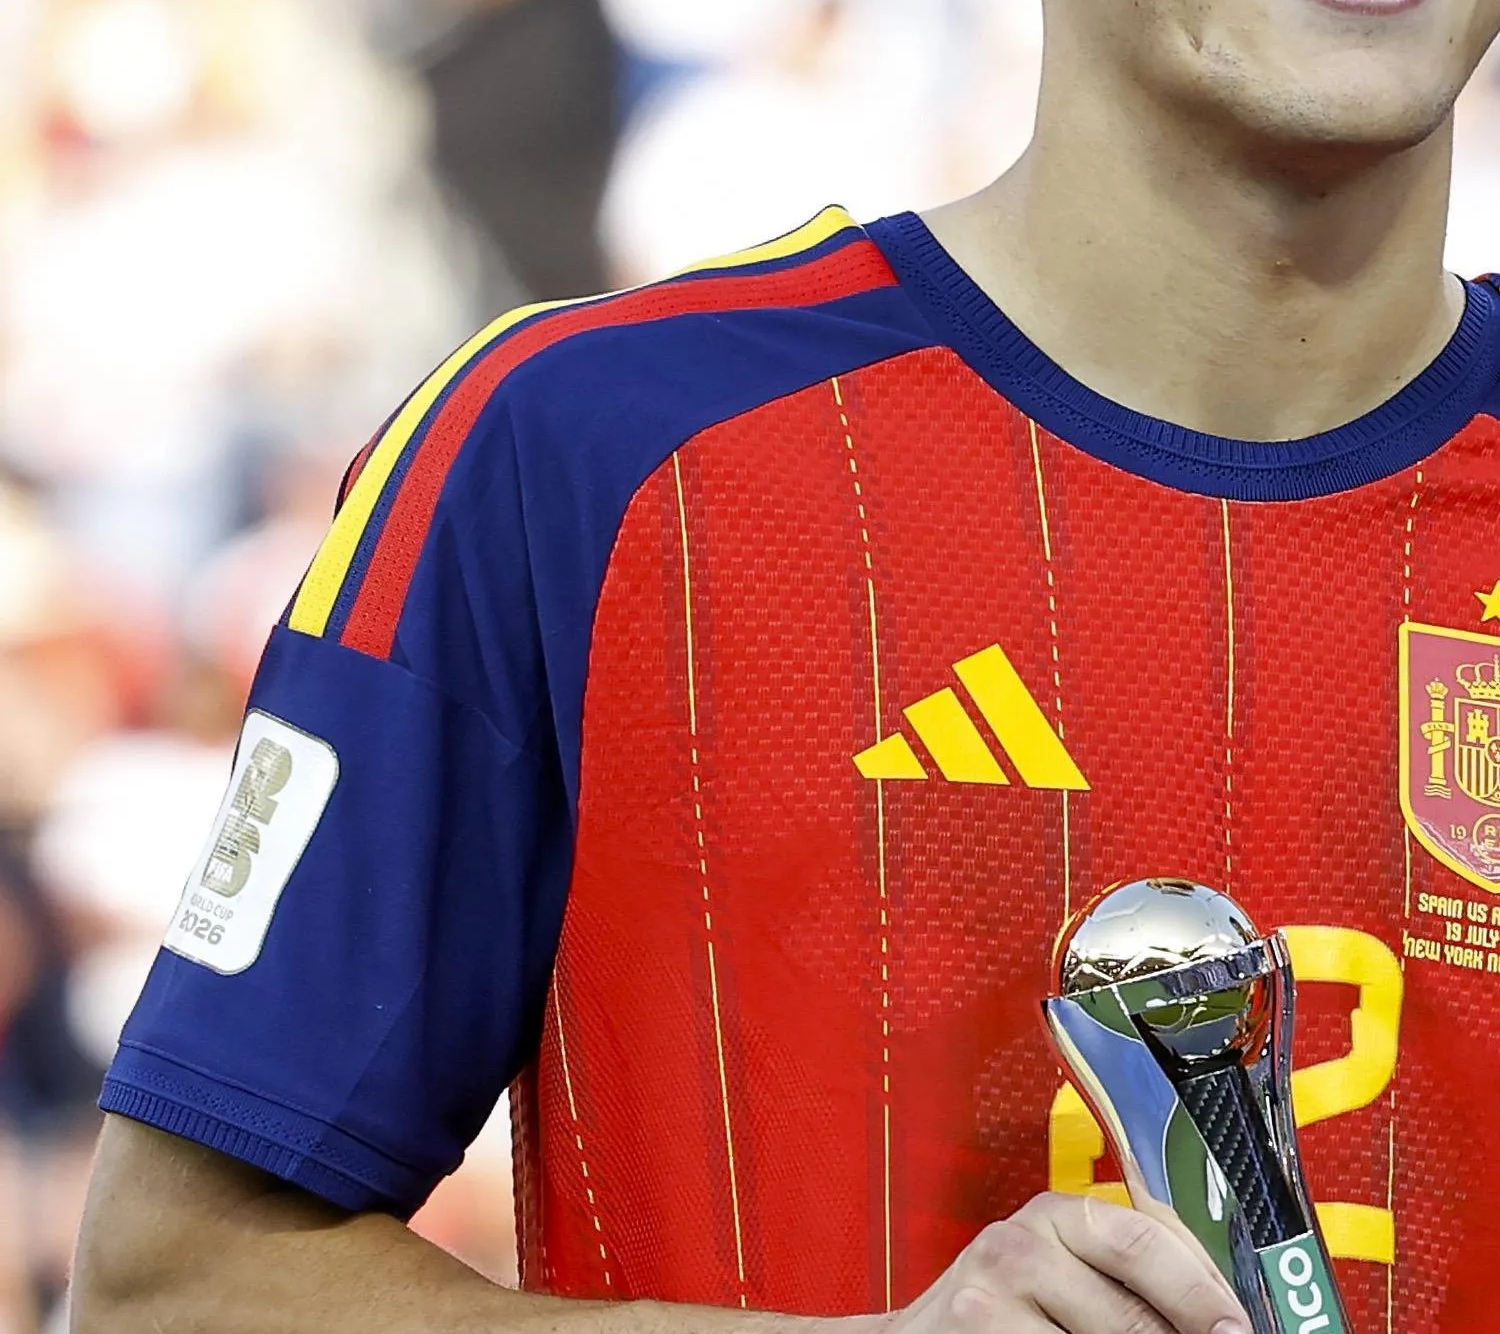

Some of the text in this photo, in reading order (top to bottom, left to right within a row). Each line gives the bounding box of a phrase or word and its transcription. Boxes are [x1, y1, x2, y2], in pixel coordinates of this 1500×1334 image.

[1418, 892, 1463, 919] SPAIN
[1445, 921, 1462, 942] 19
[1464, 925, 1500, 949] JULY
[1403, 933, 1441, 961] NEW
[1444, 944, 1484, 970] YORK
